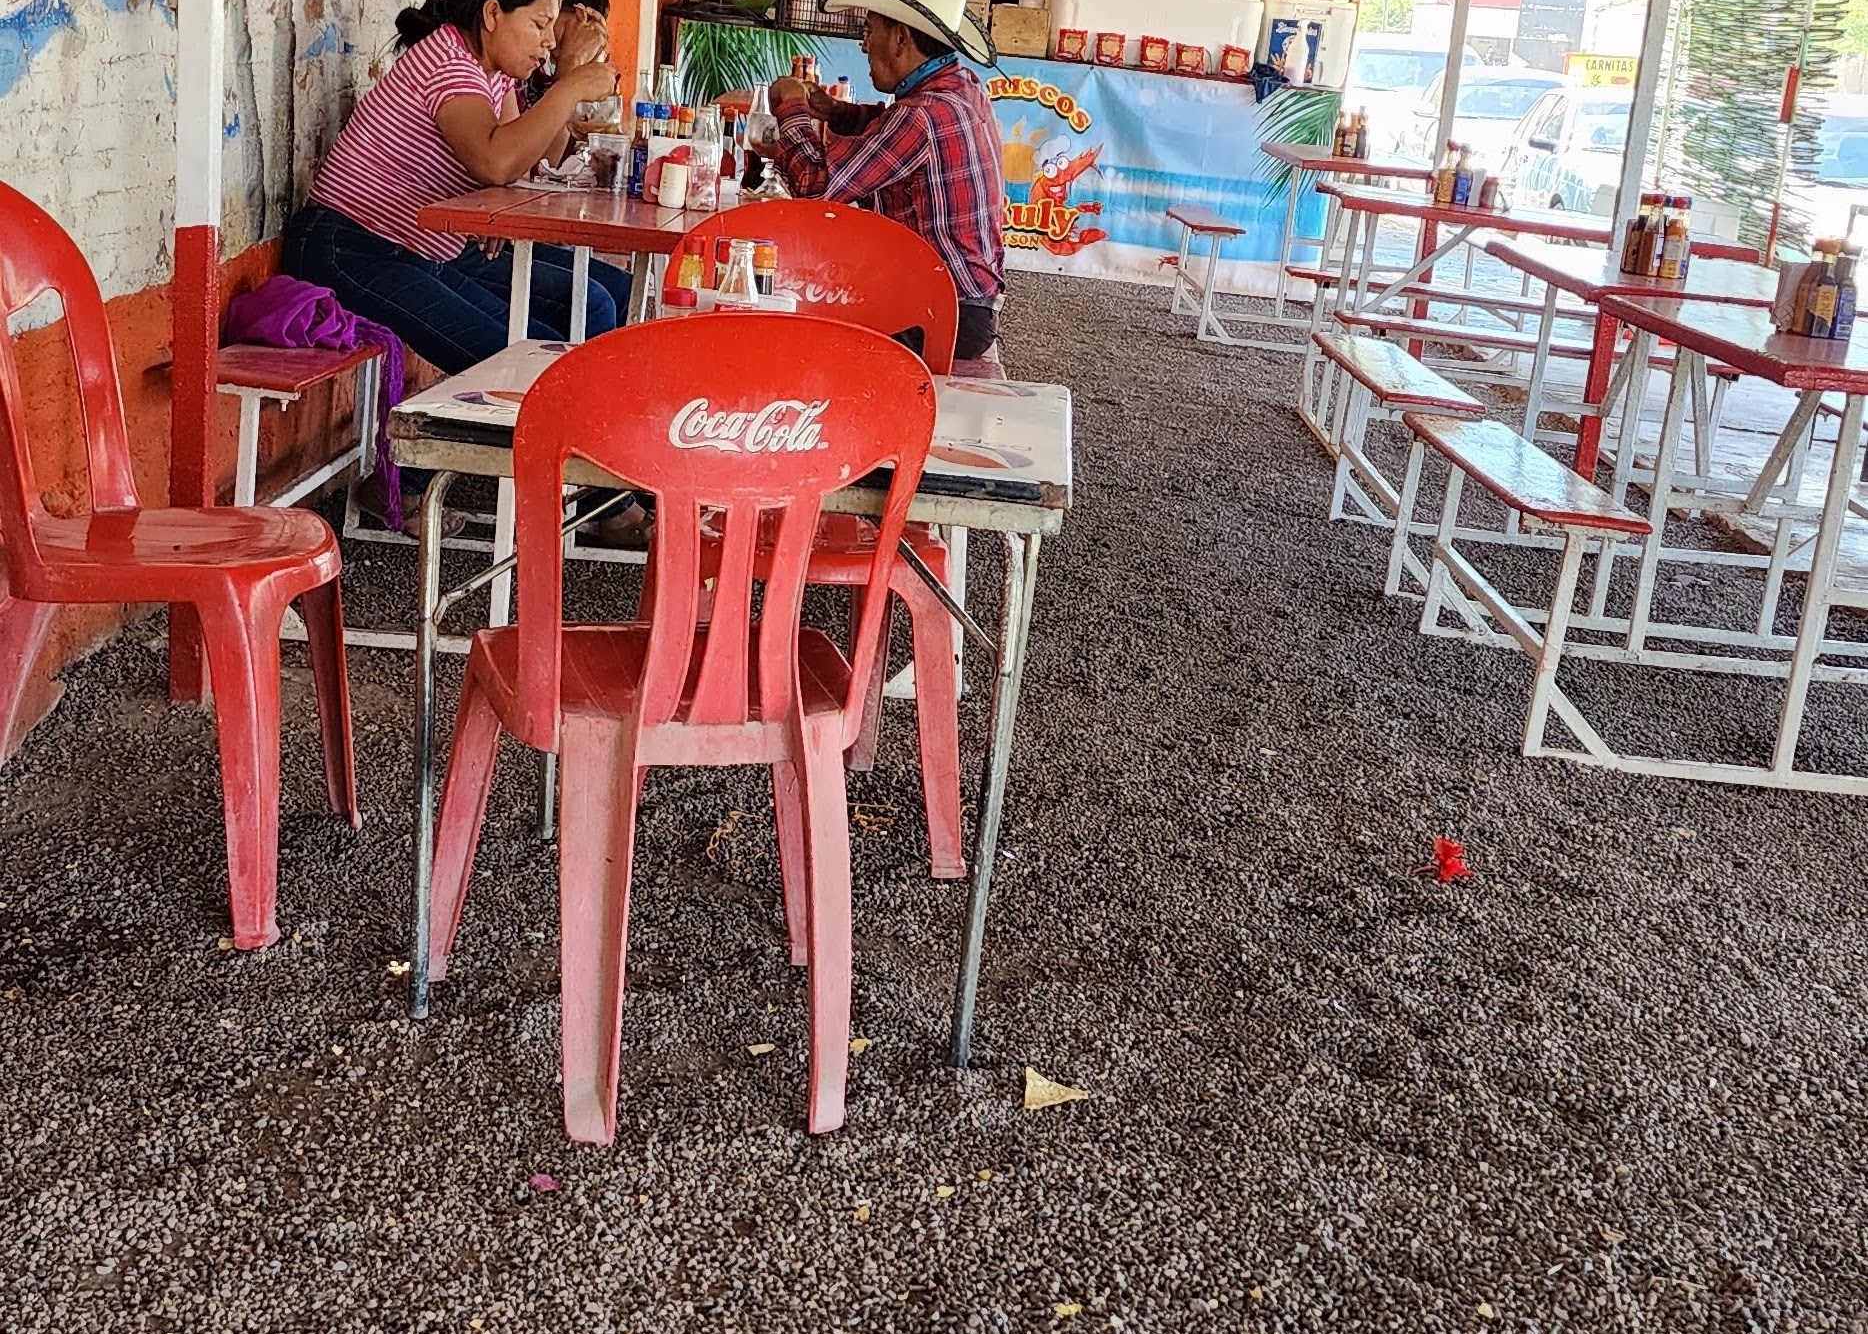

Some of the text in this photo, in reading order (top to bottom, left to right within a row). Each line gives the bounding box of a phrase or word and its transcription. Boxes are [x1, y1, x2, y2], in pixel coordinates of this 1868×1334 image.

[1586, 58, 1634, 72] CARNITAS
[1009, 234, 1040, 248] SON
[669, 397, 830, 453] Coca-Cola
